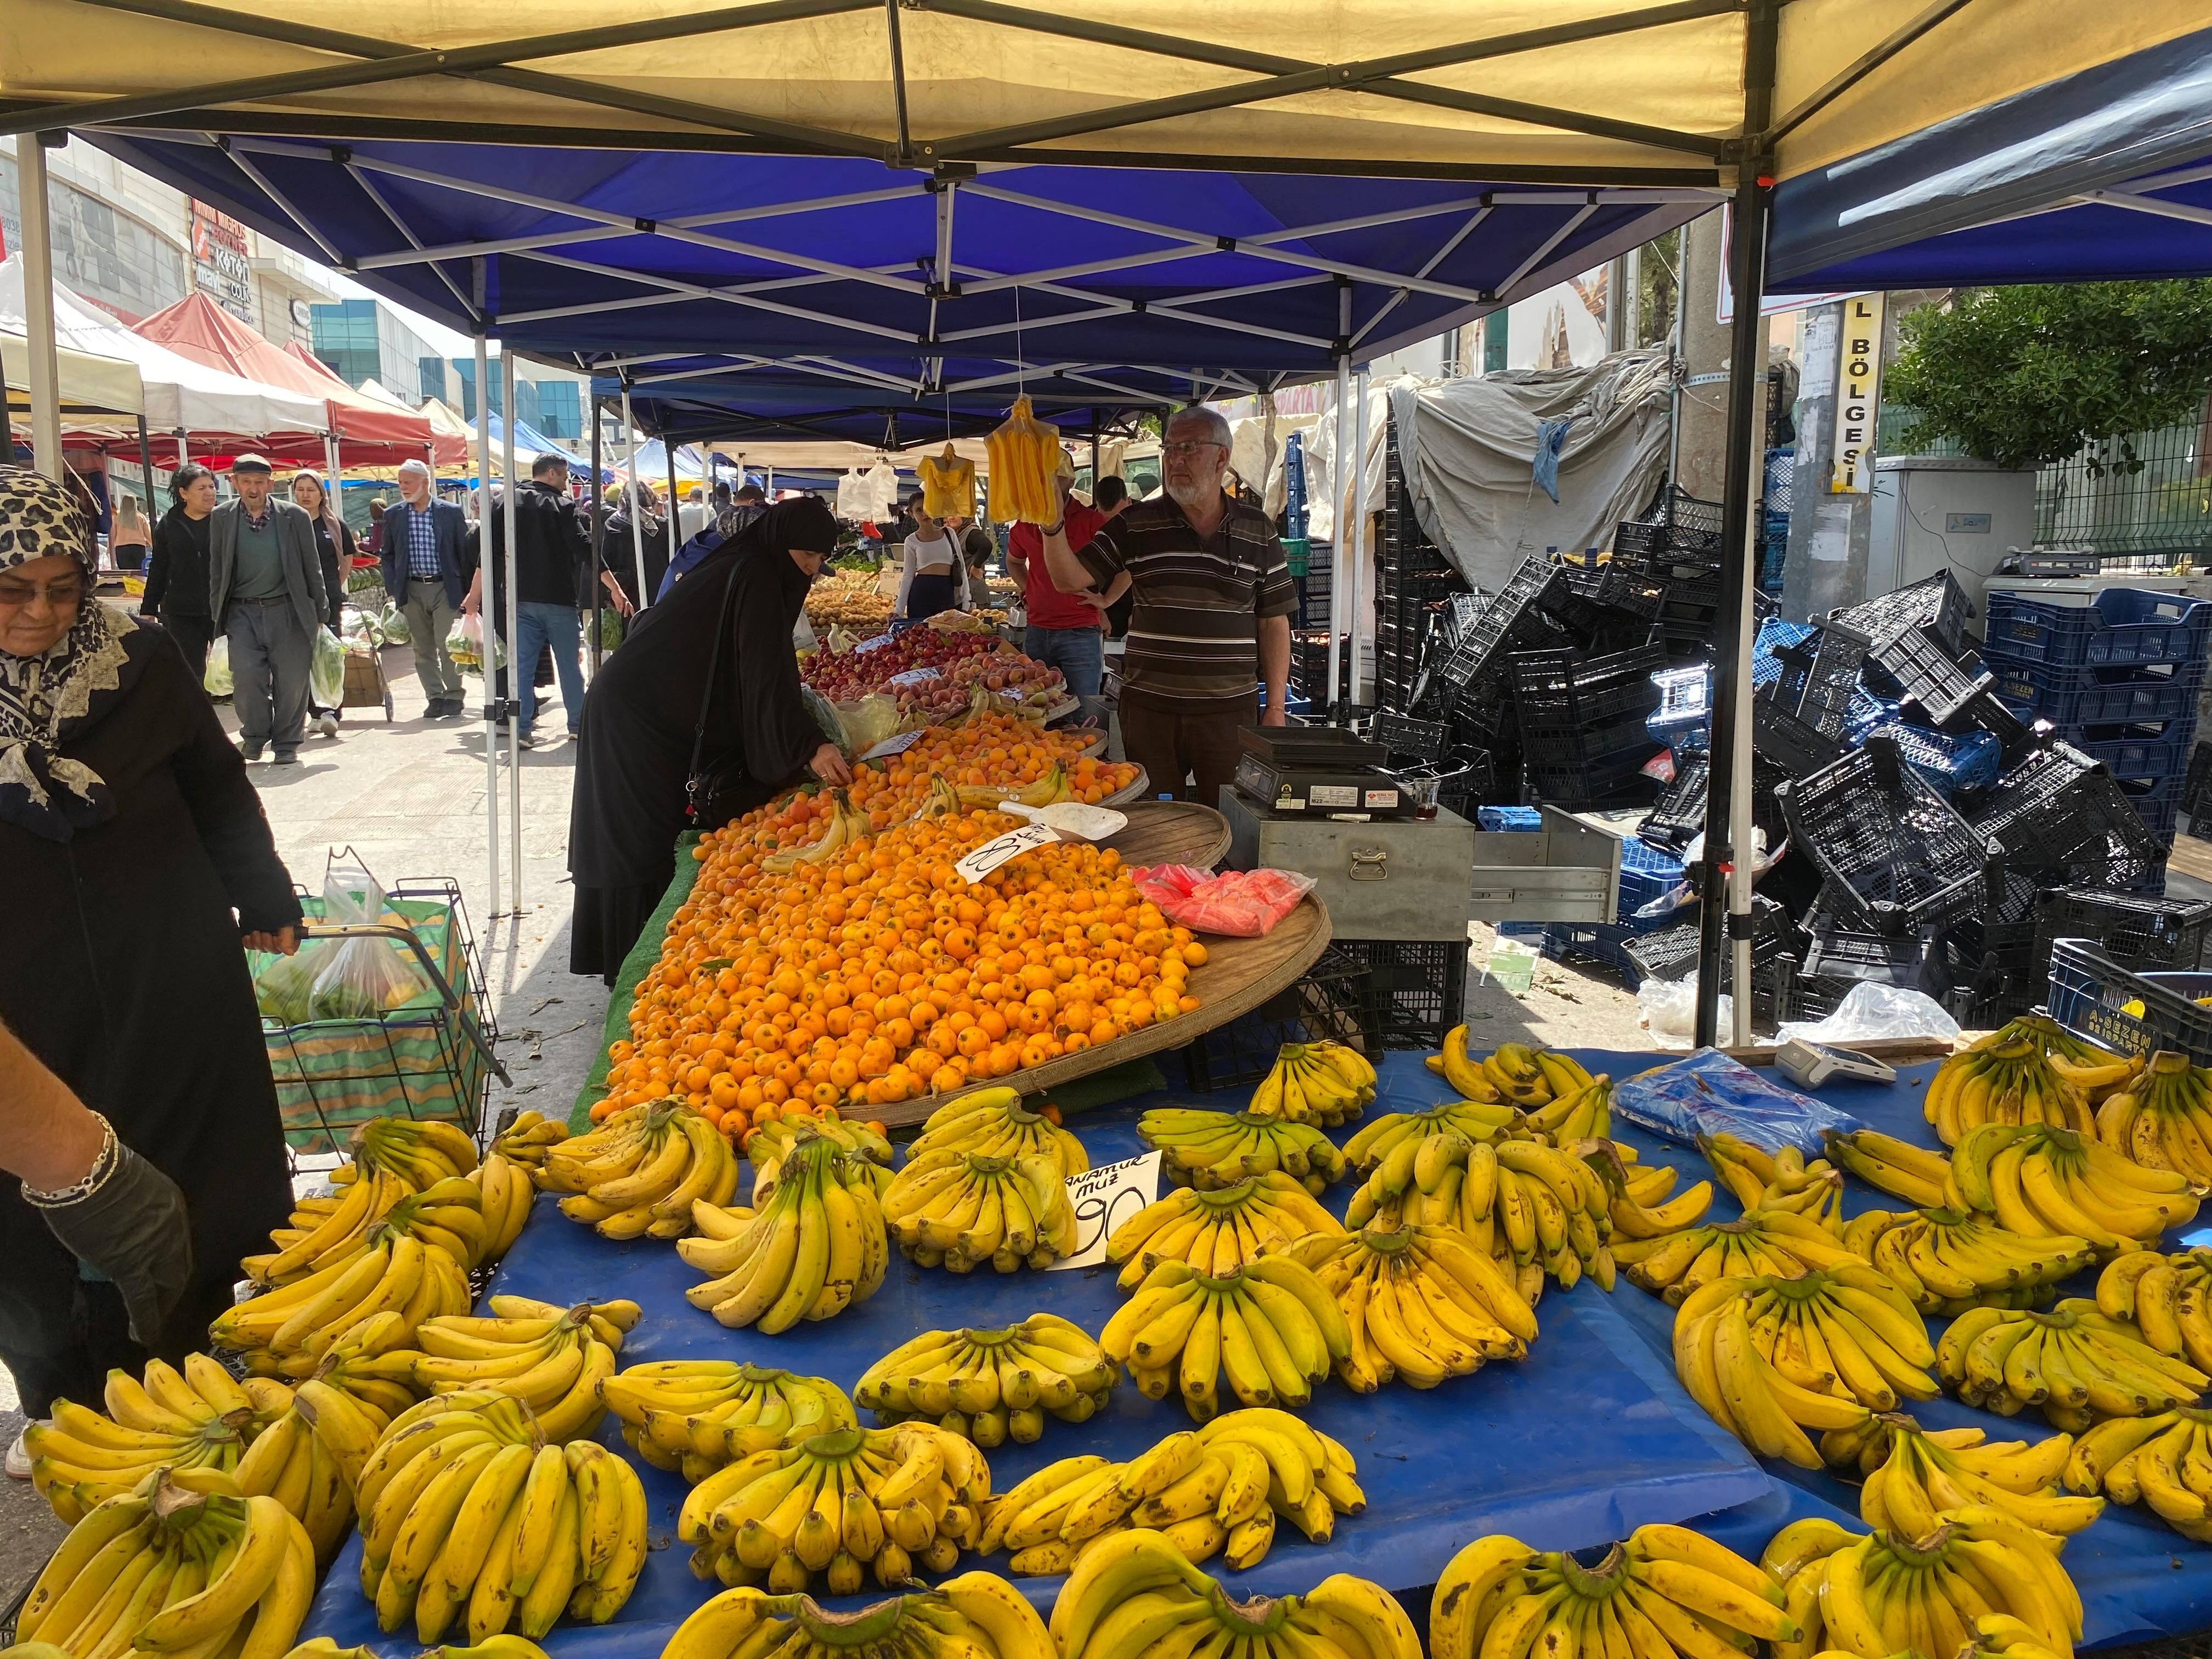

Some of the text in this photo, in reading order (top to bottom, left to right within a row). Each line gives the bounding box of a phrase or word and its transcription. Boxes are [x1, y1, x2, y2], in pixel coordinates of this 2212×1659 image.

[1843, 338, 1870, 487] BÖLGESİ
[966, 838, 1022, 872] 80
[1064, 1156, 1150, 1187] ANAMUR
[1075, 1173, 1119, 1199] MUZ
[1070, 1186, 1146, 1257] 90
